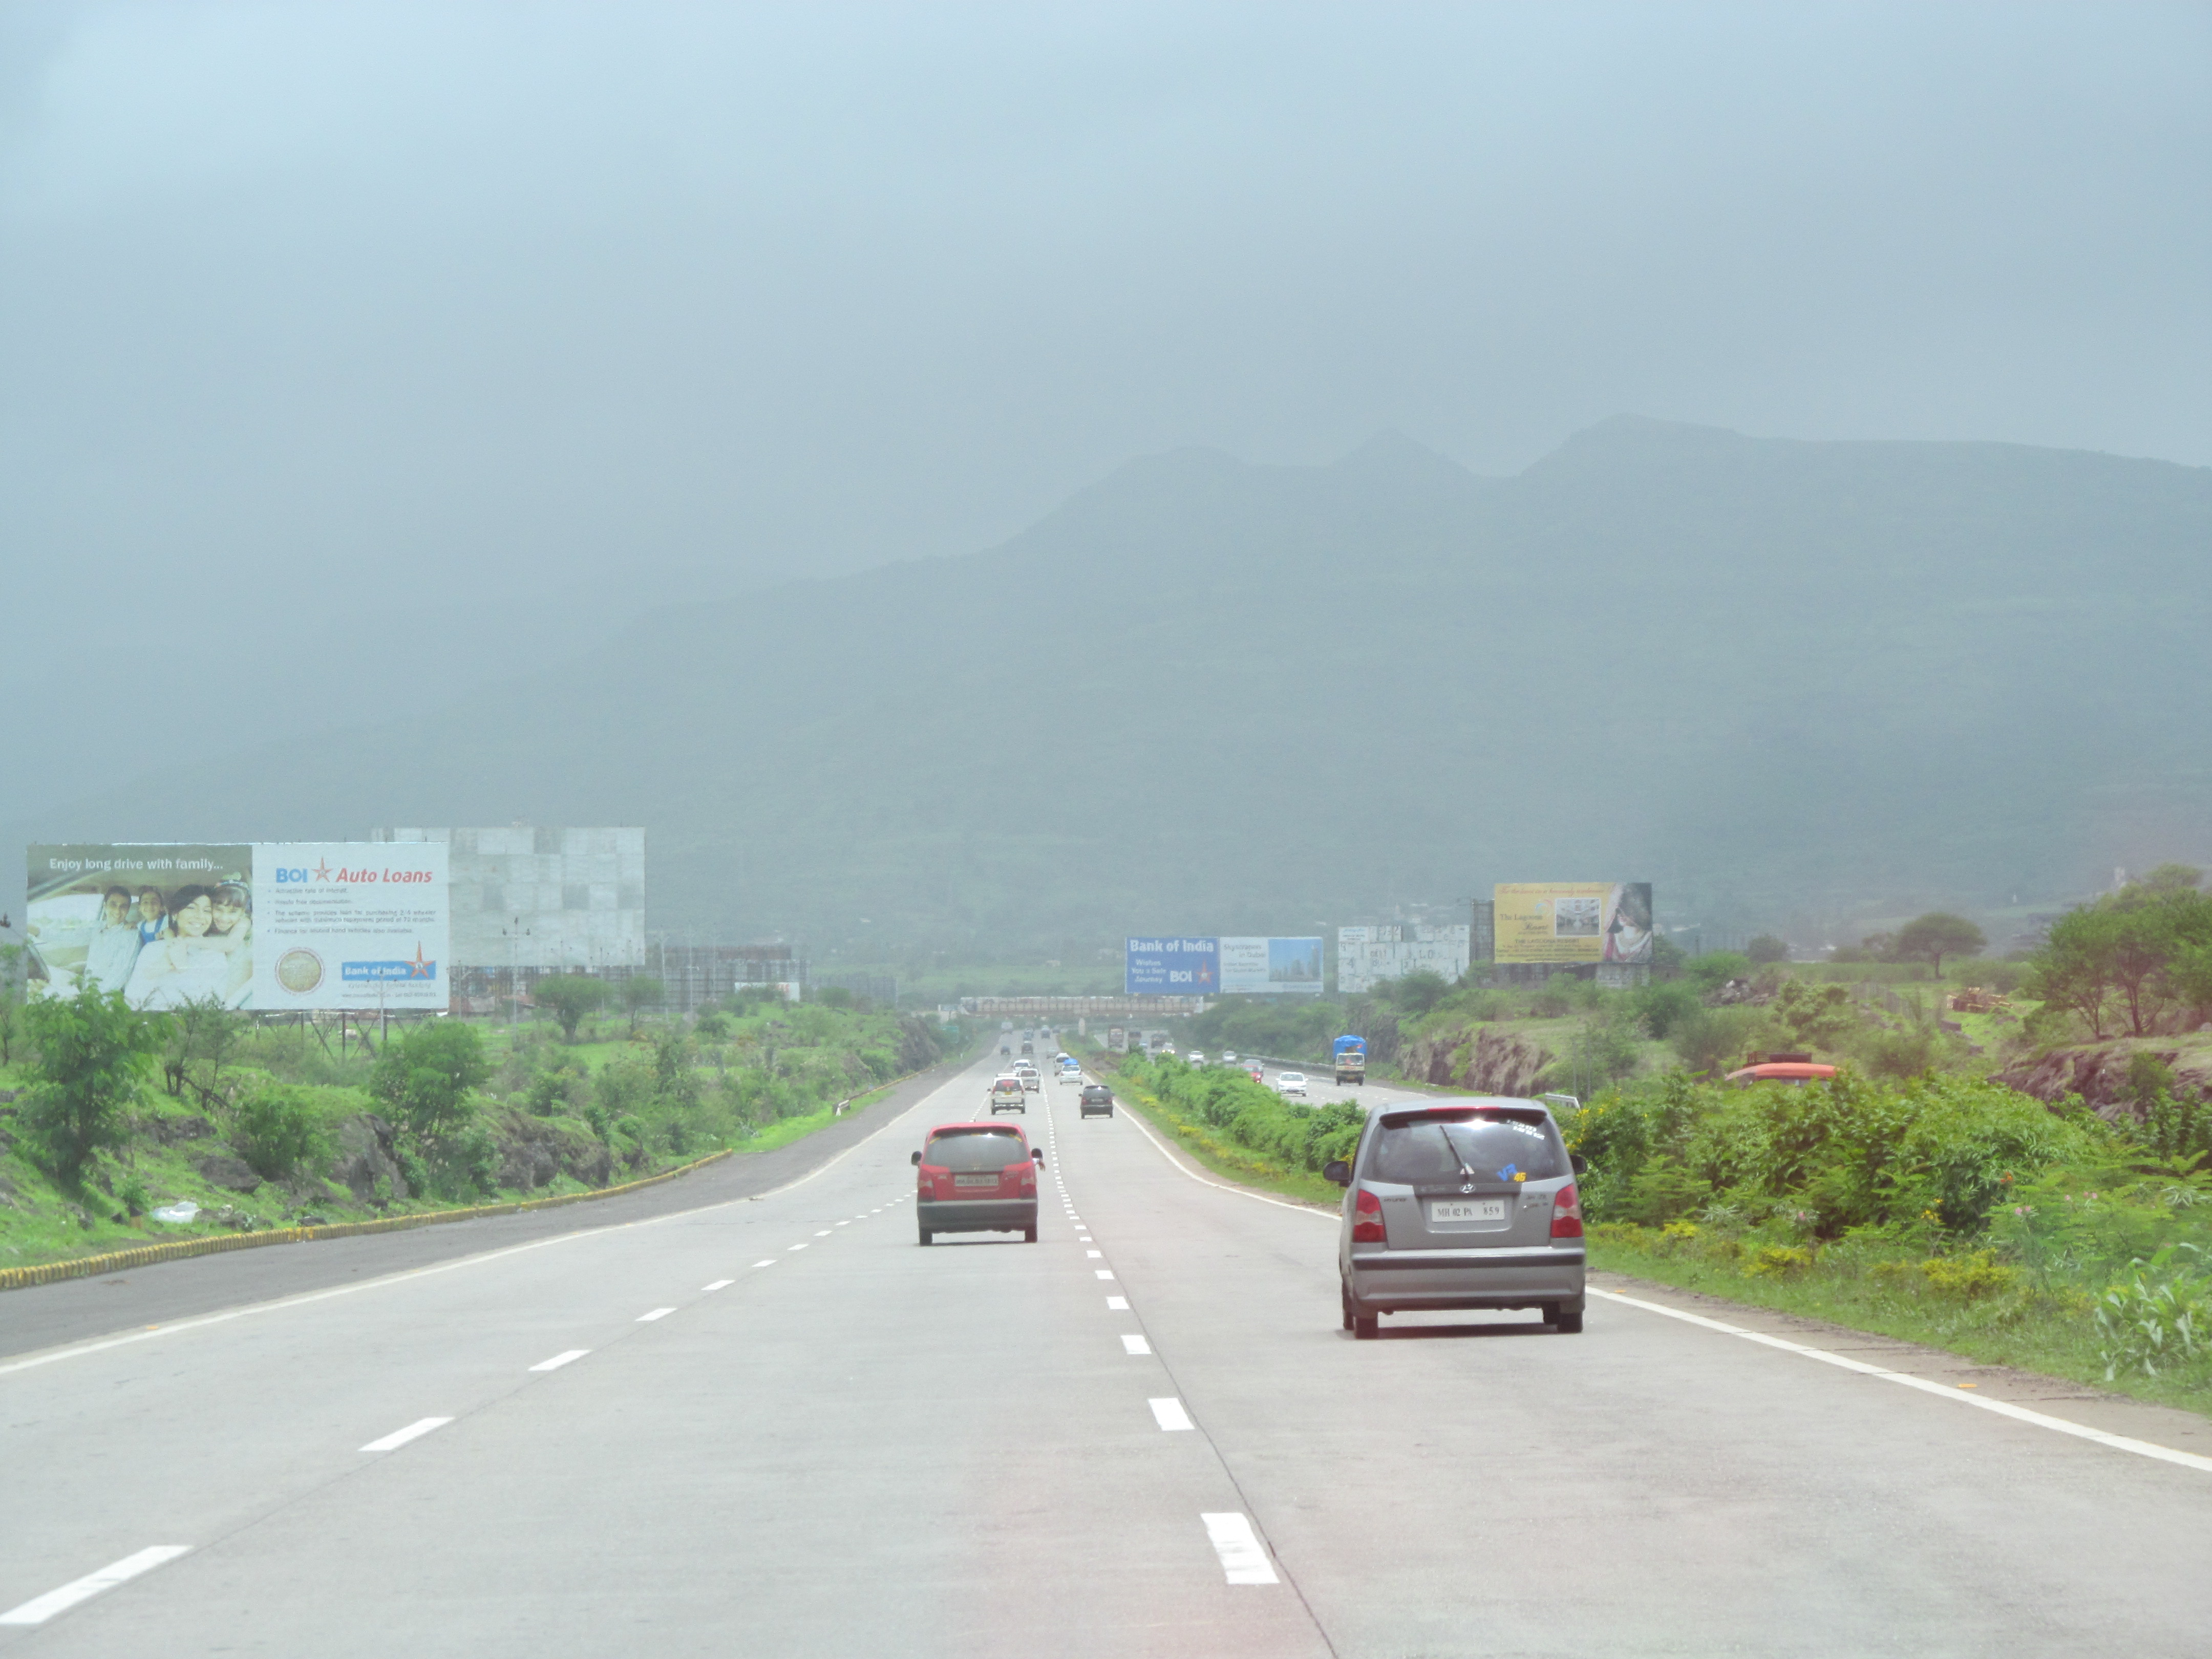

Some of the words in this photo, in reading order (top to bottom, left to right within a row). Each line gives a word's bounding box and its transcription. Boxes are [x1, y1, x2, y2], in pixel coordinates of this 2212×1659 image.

[50, 858, 81, 871] Enjoy
[85, 858, 111, 871] long
[114, 858, 143, 869] drive
[146, 858, 173, 869] with
[176, 858, 223, 871] family...
[275, 867, 307, 883] BOI
[335, 867, 377, 883] Auto
[382, 867, 433, 883] Loans
[1130, 939, 1163, 952] Bank
[1166, 940, 1179, 952] of
[1183, 939, 1215, 952] India
[345, 966, 369, 975] Bank
[371, 966, 381, 975] of
[384, 966, 407, 975] India
[1169, 970, 1192, 982] BOI
[1438, 1208, 1450, 1217] MH
[1453, 1208, 1460, 1217] 02
